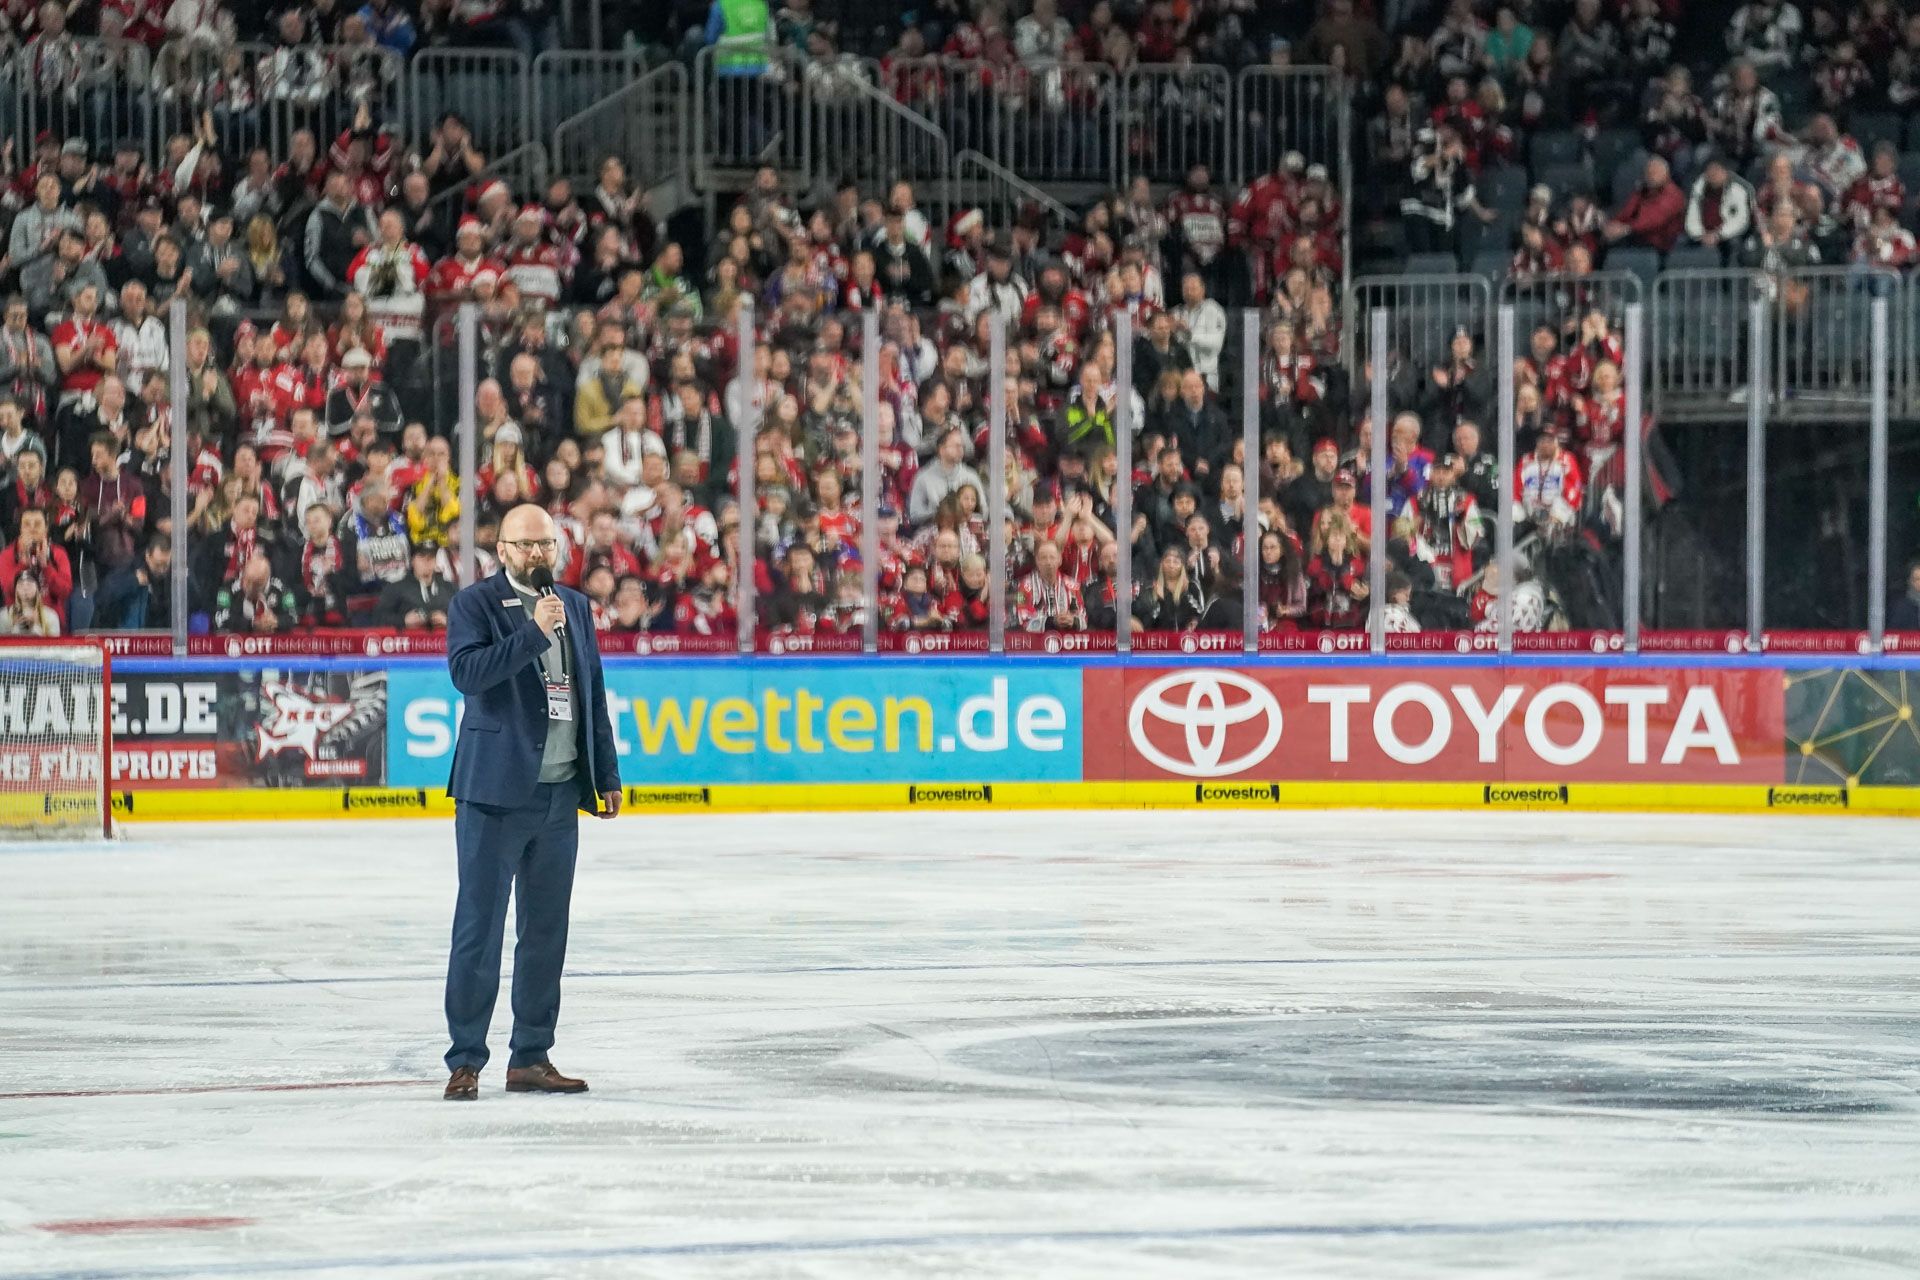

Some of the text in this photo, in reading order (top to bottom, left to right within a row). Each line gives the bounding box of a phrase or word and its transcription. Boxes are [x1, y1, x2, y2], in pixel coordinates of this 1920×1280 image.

[275, 638, 352, 653] IMMOBILIEN
[785, 634, 814, 651] OTT
[924, 633, 950, 651] OTT
[1062, 633, 1089, 650] OTT
[1199, 634, 1305, 650] OTT IMOBILIEN
[1337, 634, 1442, 650] OTT IMOBILIEN
[1308, 683, 1740, 765] TOYOTA
[111, 750, 216, 780] PROFIS
[917, 788, 983, 802] covestro
[1203, 787, 1270, 800] covestro
[1491, 788, 1558, 802] covestro
[1774, 792, 1841, 804] covestro
